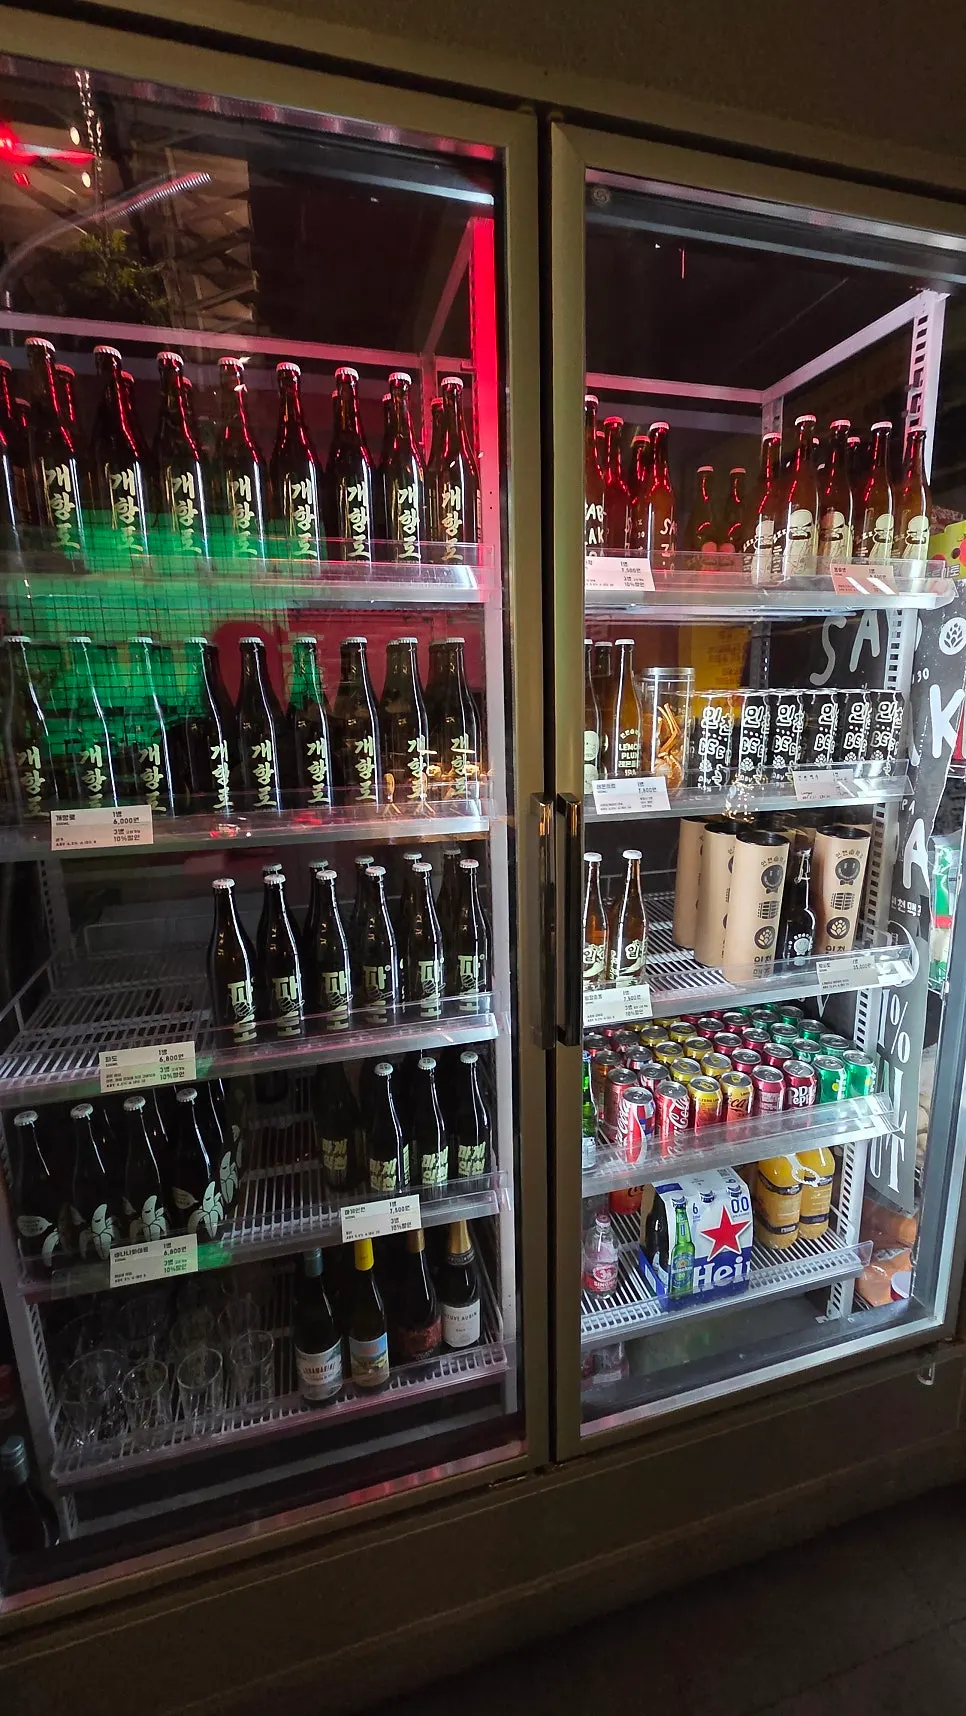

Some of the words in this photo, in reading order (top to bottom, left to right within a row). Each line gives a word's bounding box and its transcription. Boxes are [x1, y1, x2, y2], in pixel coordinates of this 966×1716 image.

[46, 463, 81, 550] 개항로
[110, 467, 143, 552] 개항로
[172, 471, 202, 555] 개항로
[231, 474, 258, 556] 개항로
[292, 478, 317, 557] 개항로
[347, 481, 370, 559] 개항로
[398, 483, 420, 559] 개항로
[441, 485, 464, 561] 개항로
[585, 503, 607, 522] AB
[251, 739, 277, 806] 개항로
[306, 736, 329, 803] 개항로
[354, 735, 376, 800] 개항로
